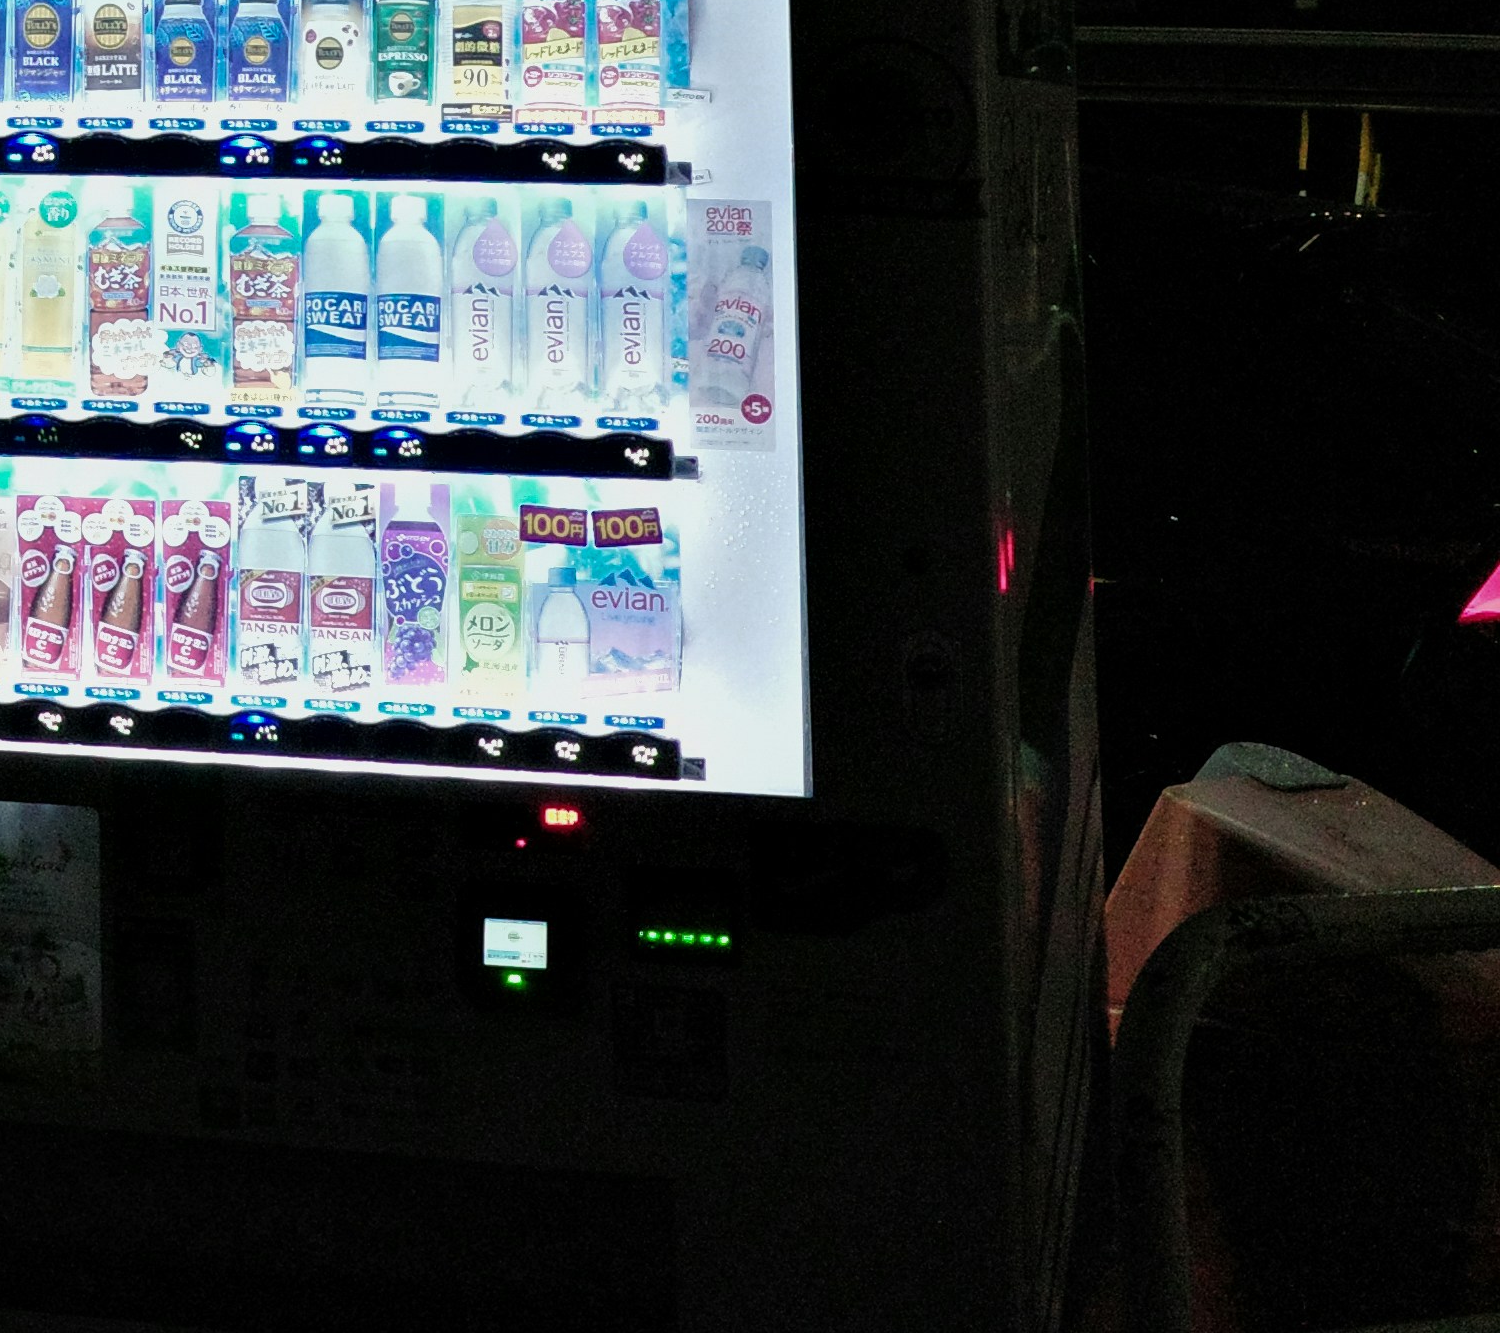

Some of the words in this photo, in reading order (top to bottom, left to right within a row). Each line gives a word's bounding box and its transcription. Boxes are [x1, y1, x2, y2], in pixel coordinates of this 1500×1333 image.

[22, 56, 59, 66] BLACK
[378, 52, 428, 62] ESPRESSO
[163, 74, 202, 84] BLACK
[238, 74, 276, 84] BLACK
[462, 68, 489, 88] 90
[706, 205, 752, 220] evian
[94, 265, 143, 289] むぎ茶
[235, 273, 292, 298] むぎ茶
[159, 300, 207, 325] No.1
[306, 298, 365, 312] POCARI
[379, 301, 439, 316] POCARI
[306, 311, 362, 325] SWEAT
[379, 314, 436, 327] SWEAT
[468, 298, 489, 361] evian
[543, 299, 564, 364] evian
[620, 301, 641, 365] evian
[707, 338, 746, 360] 200
[261, 490, 305, 516] No.1
[331, 495, 376, 522] No.1
[523, 513, 585, 539] 100円
[596, 516, 659, 540] 100円
[386, 569, 443, 599] ぶどう
[592, 588, 665, 613] evian
[240, 622, 300, 635] TANSAN
[466, 615, 511, 632] メロン
[311, 628, 372, 641] TANSAN
[471, 638, 505, 651] ソーダ
